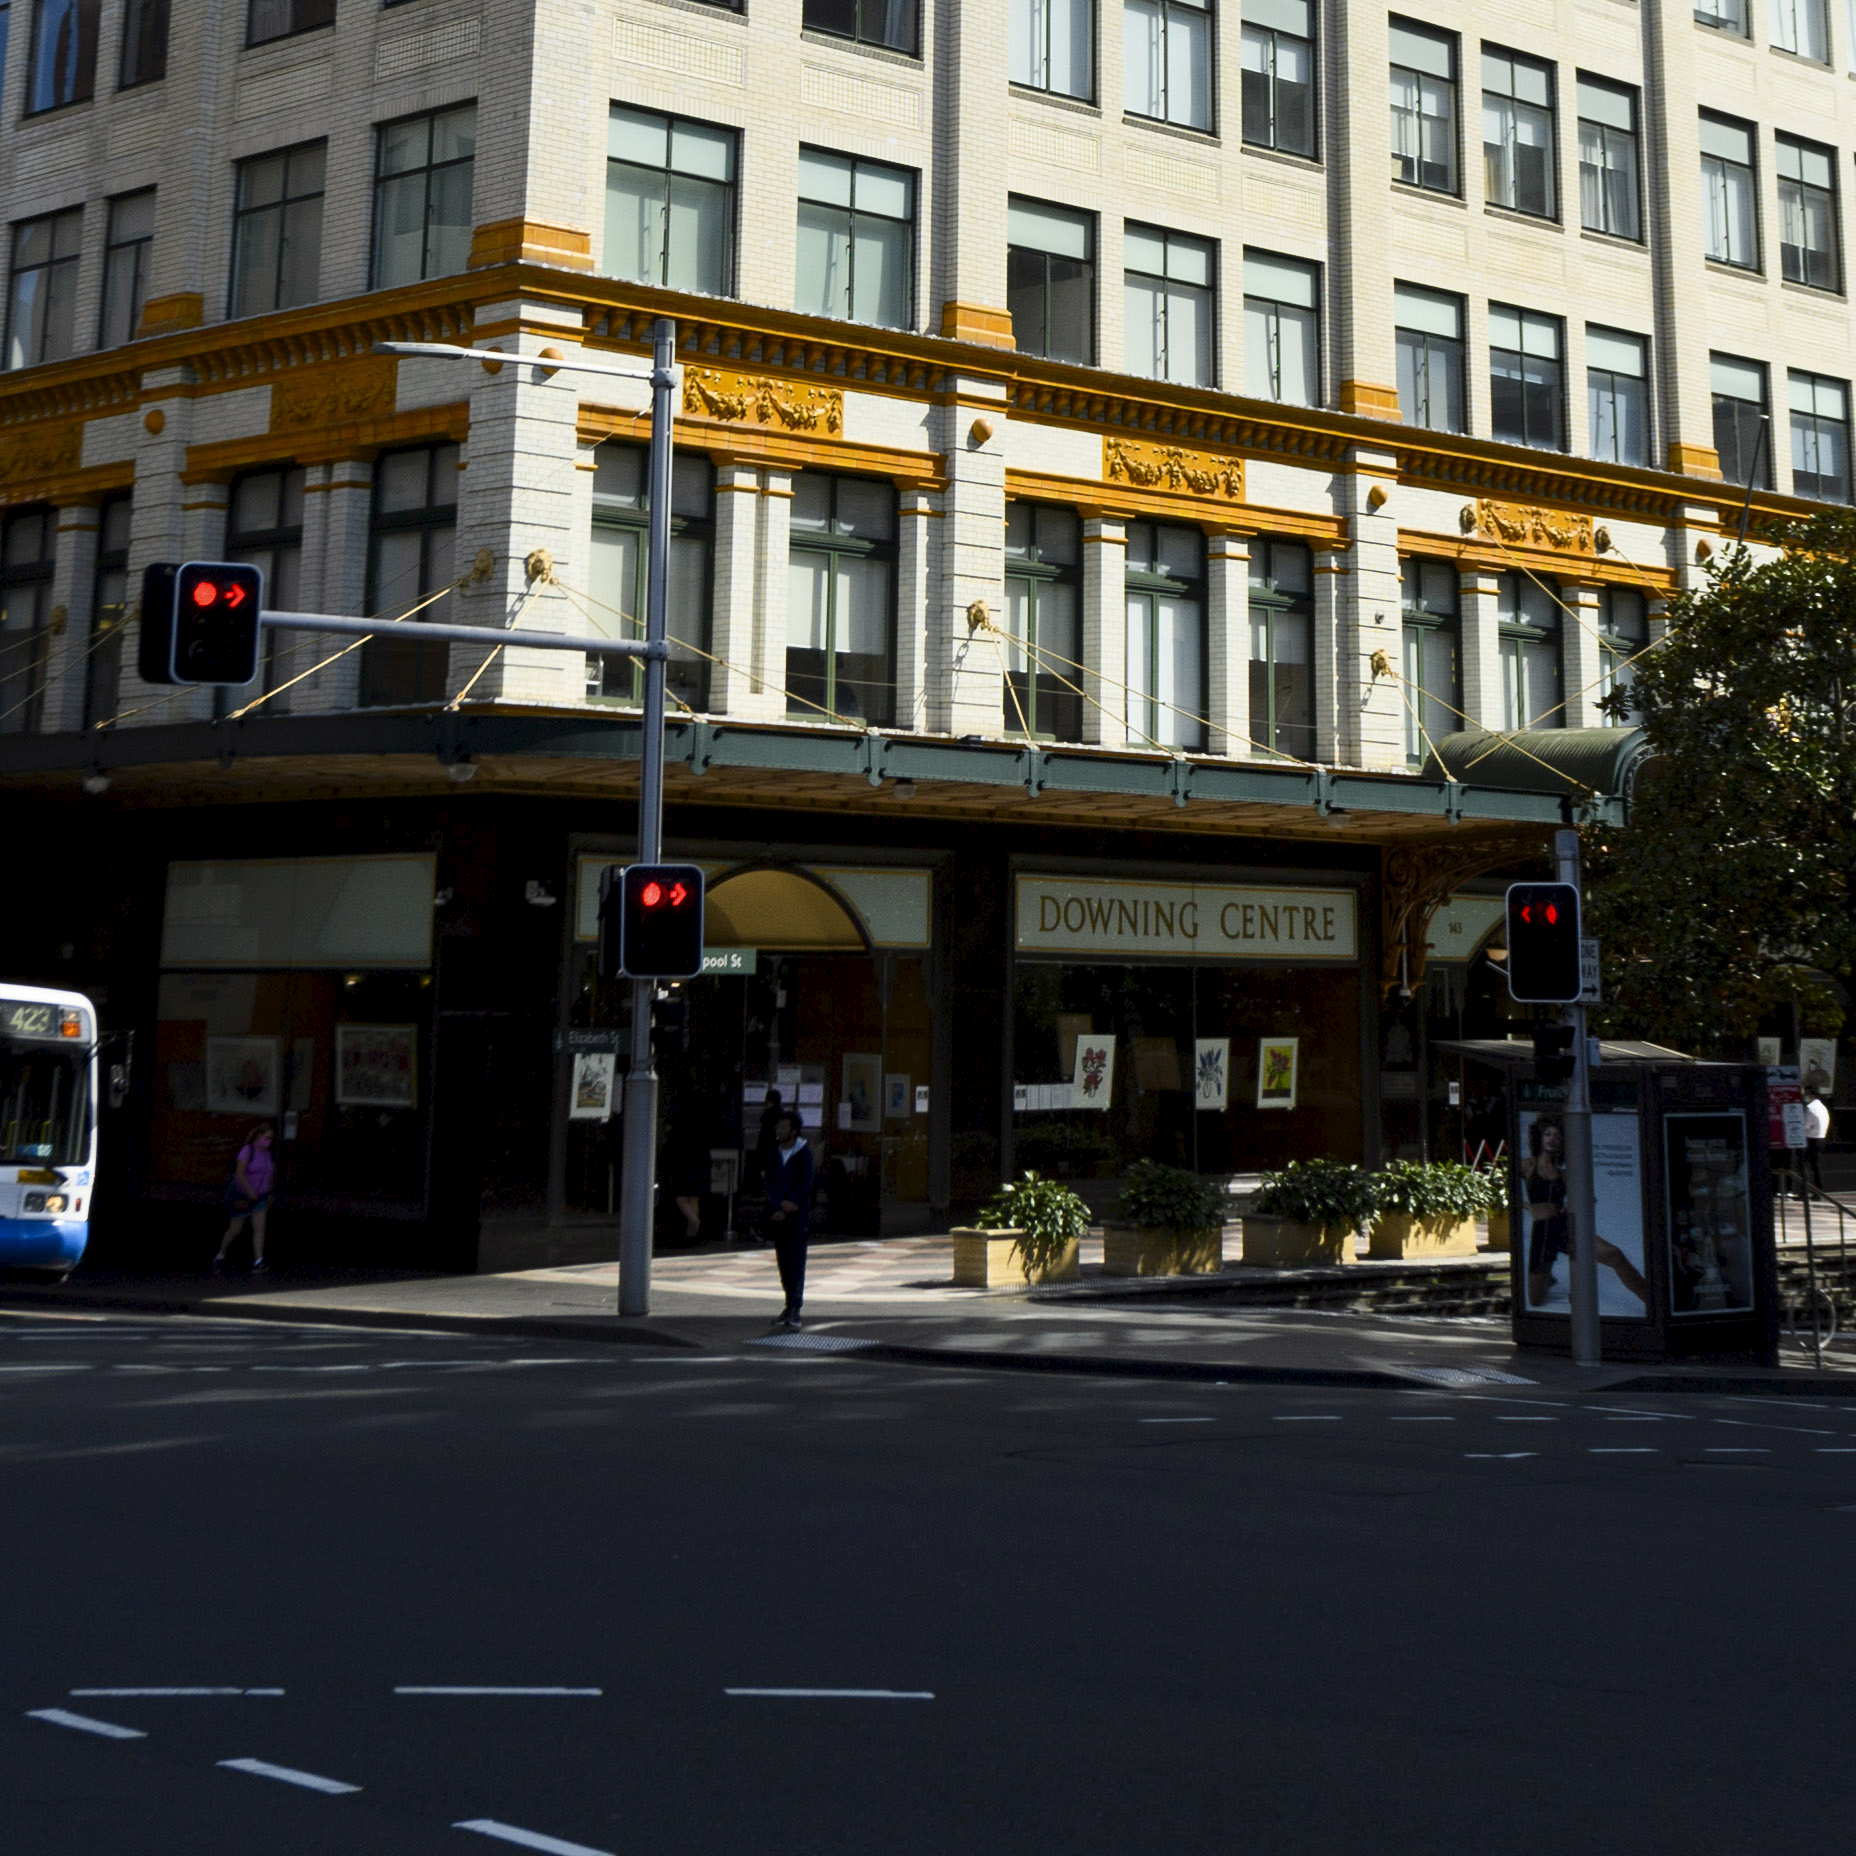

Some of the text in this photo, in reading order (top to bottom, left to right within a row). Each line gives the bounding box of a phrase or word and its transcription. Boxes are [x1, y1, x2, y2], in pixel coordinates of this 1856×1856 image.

[1038, 894, 1336, 942] DOWNING CENTRE
[1448, 921, 1463, 934] 143
[702, 953, 743, 971] pool St
[10, 1006, 51, 1033] 423
[568, 1030, 608, 1044] Elizabeth
